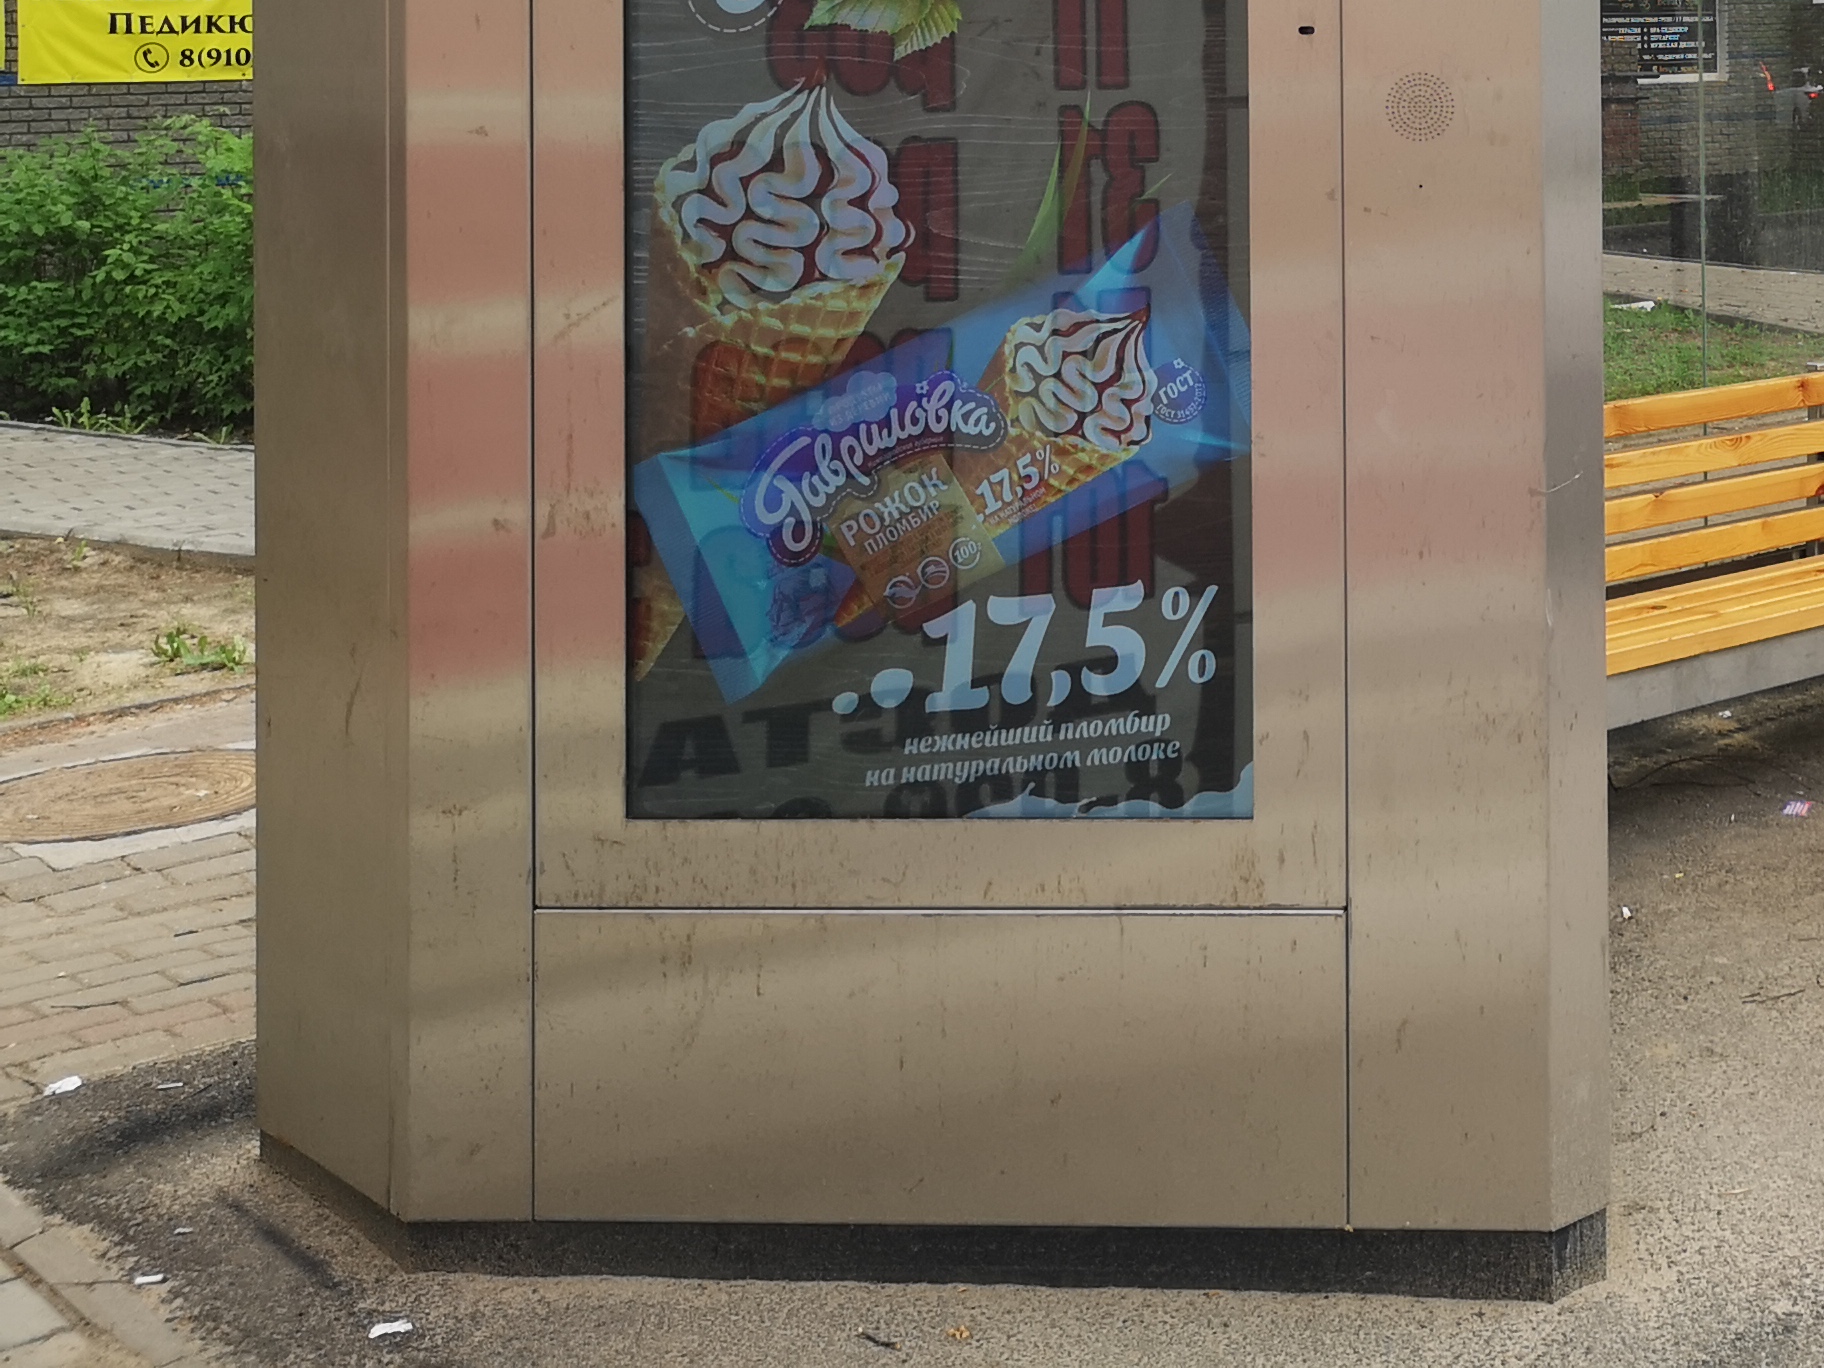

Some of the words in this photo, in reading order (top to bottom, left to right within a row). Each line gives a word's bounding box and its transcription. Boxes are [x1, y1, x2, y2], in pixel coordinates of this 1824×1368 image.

[107, 12, 253, 36] ПЕДИКЮ
[1158, 369, 1196, 406] ГОСТ
[839, 466, 949, 547] РОЖОК
[863, 499, 942, 556] ПЛОМБИР
[903, 718, 1054, 756] нежнейший
[1058, 709, 1172, 741] пломбир
[864, 764, 896, 788] на
[899, 749, 1082, 786] натуральном
[1085, 738, 1182, 768] молоке
